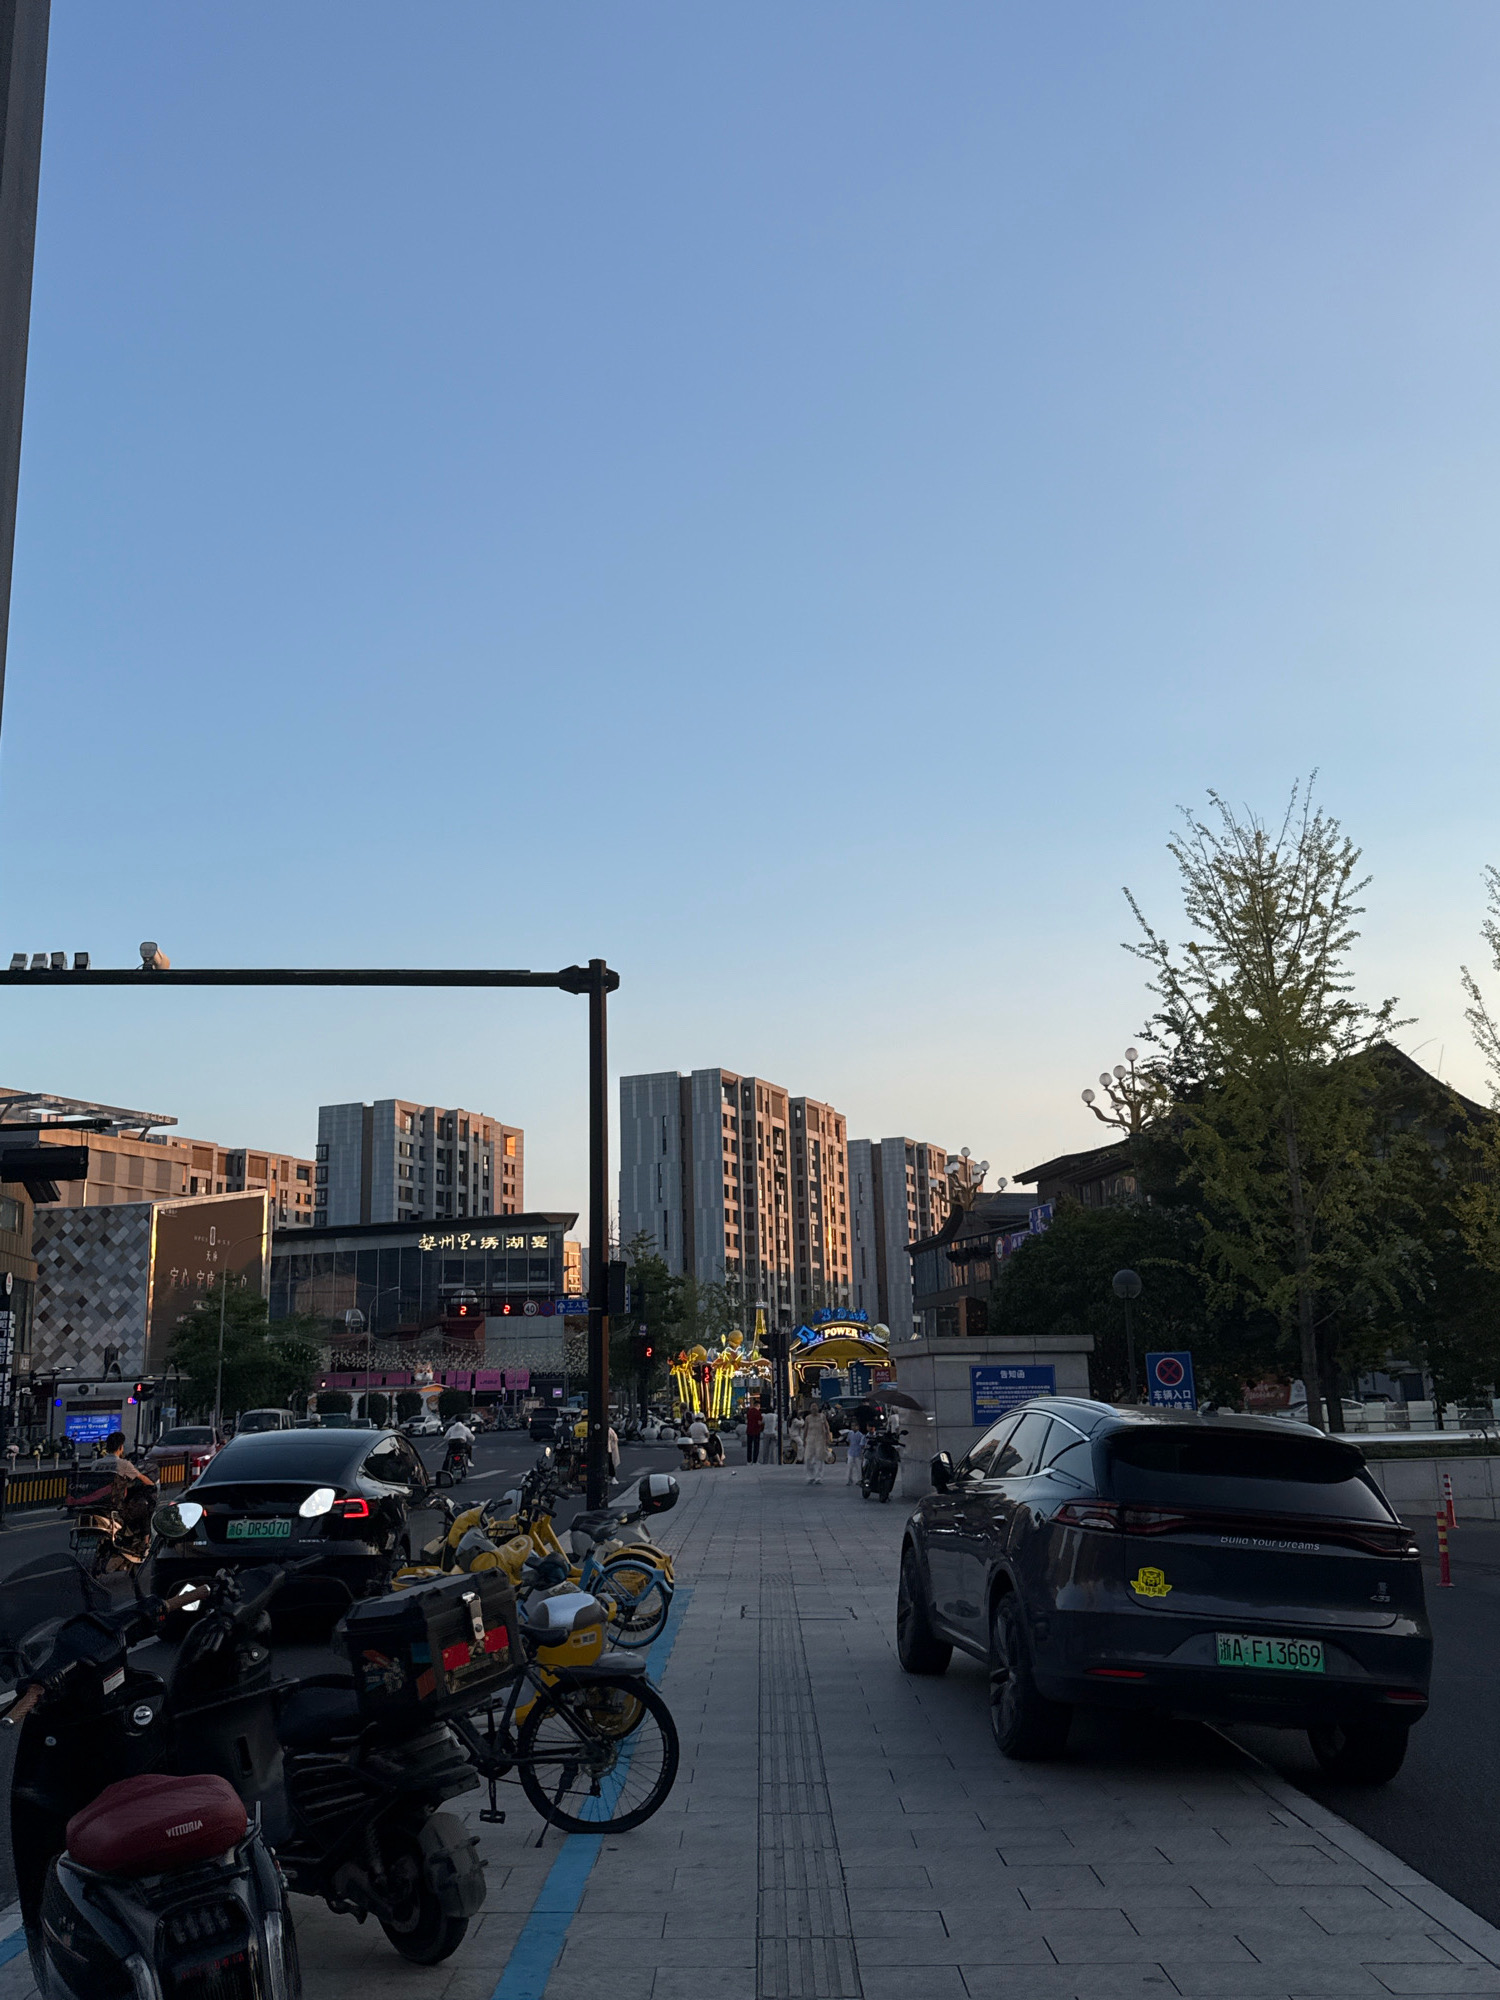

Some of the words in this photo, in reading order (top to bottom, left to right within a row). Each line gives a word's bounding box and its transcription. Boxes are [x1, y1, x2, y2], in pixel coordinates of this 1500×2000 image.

[524, 1304, 535, 1314] 40
[824, 1326, 859, 1339] POWER
[1153, 1389, 1191, 1400] 车辆入口
[1220, 1535, 1249, 1545] Build
[1252, 1537, 1277, 1548] Your
[1278, 1541, 1320, 1551] Dreams
[165, 1820, 204, 1837] VITTORIA
